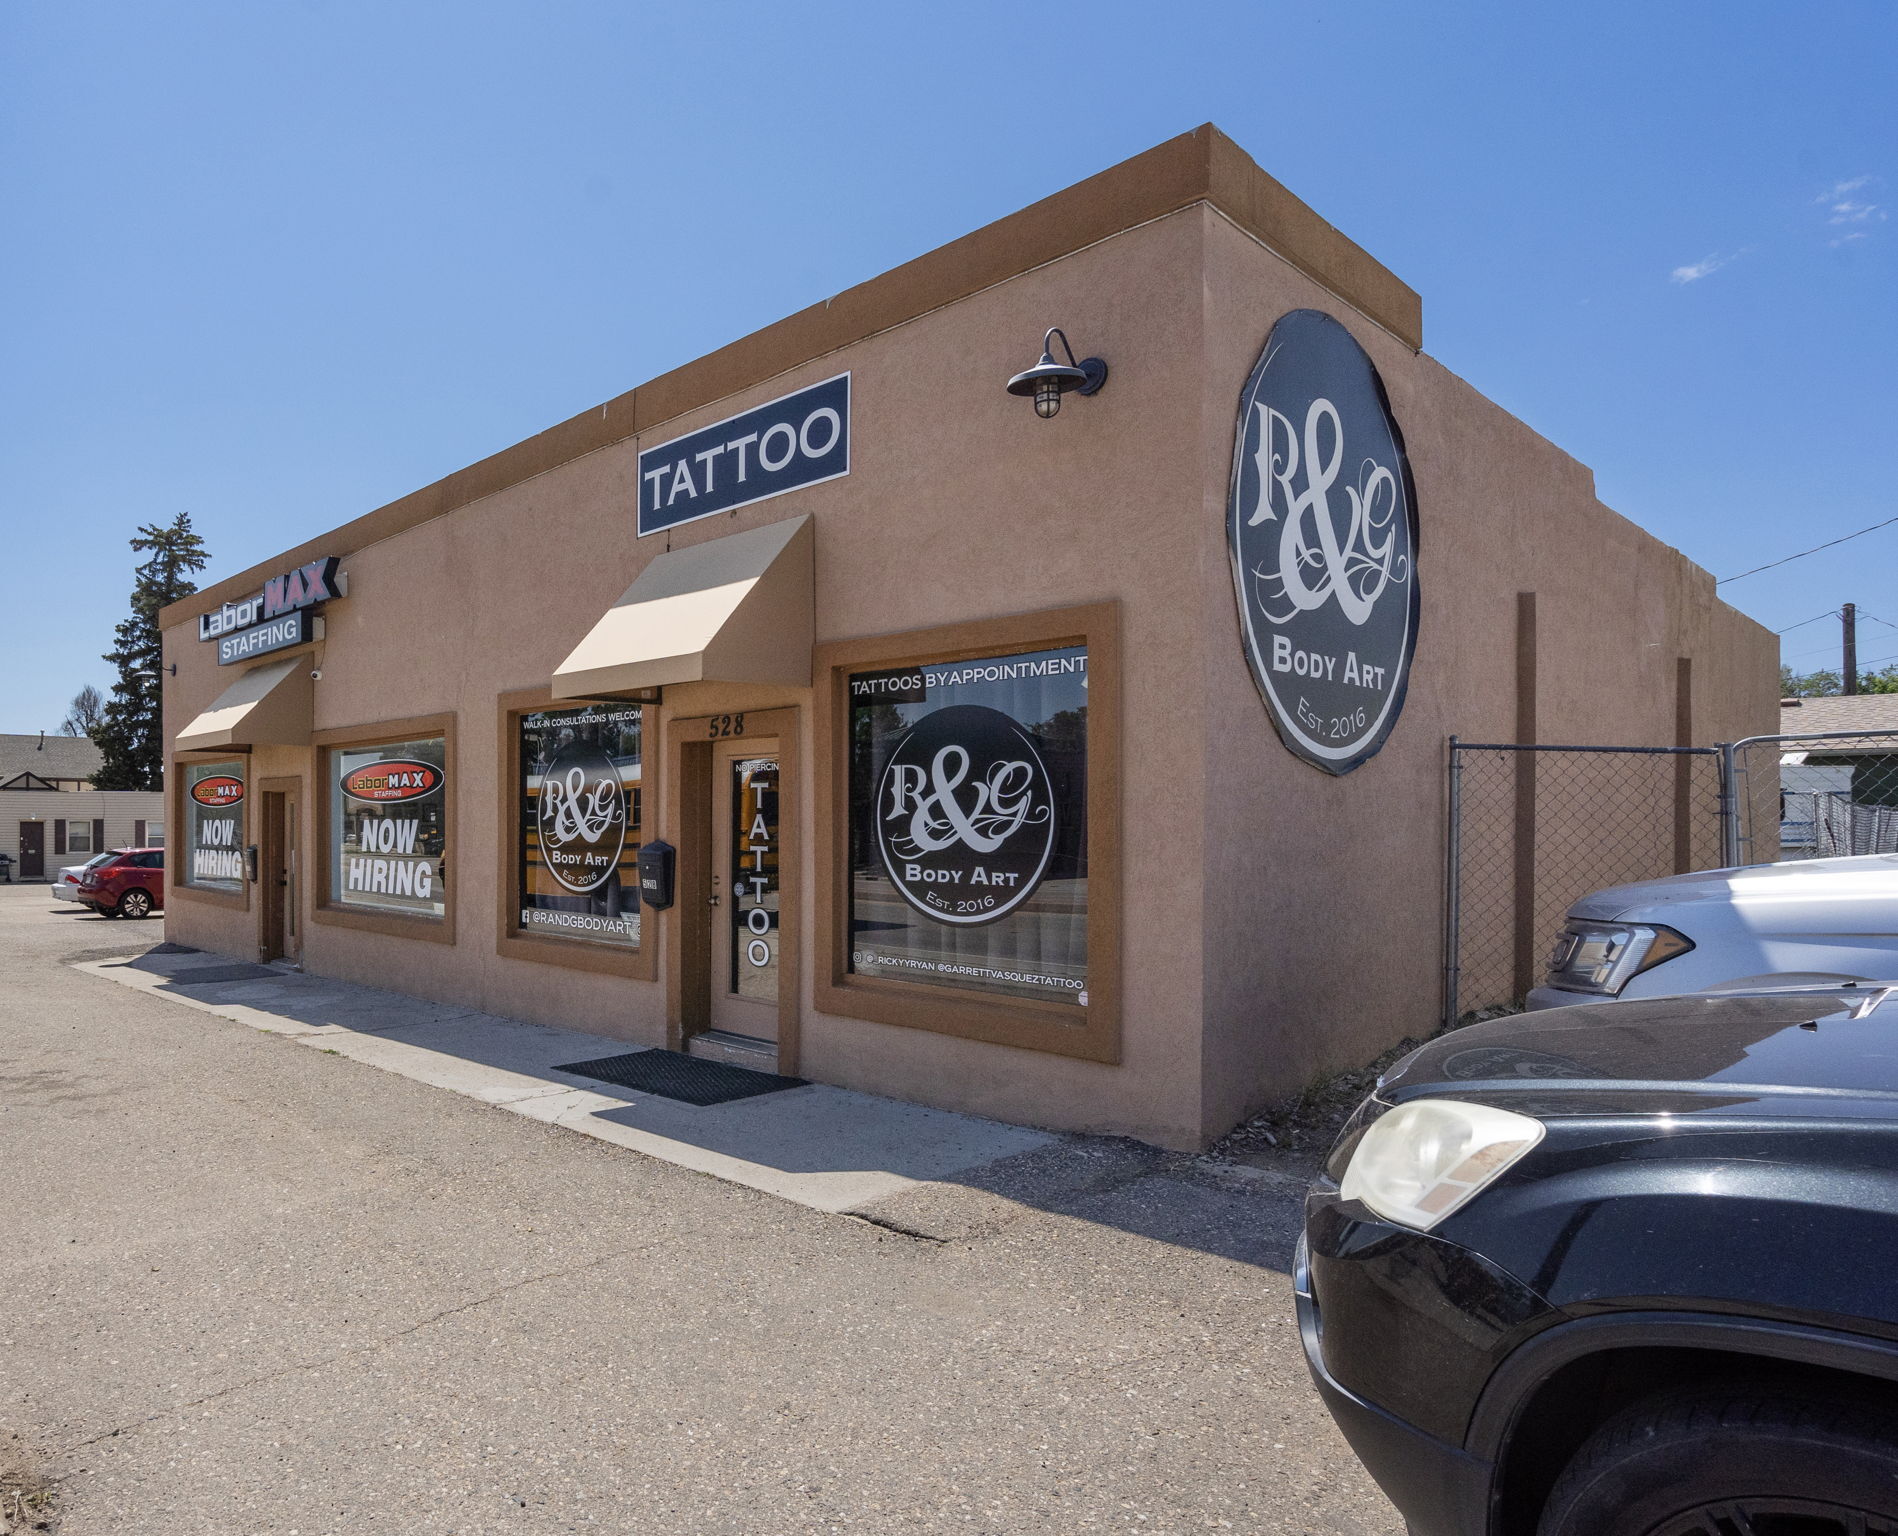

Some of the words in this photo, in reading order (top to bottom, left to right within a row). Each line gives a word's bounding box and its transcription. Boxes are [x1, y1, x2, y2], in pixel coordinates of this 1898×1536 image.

[645, 407, 840, 511] TATTOO
[1248, 397, 1408, 627] R&G
[199, 560, 335, 642] LaborMAX
[222, 620, 297, 659] STAFFING
[851, 675, 921, 695] TATTOOS
[925, 671, 948, 688] BY
[947, 656, 1088, 685] APPOINTMENT
[523, 718, 550, 730] WALK-IN
[551, 714, 606, 727] CONSULTATIONS
[709, 712, 745, 738] 528
[1330, 706, 1366, 738] 2016
[351, 772, 425, 791] LaborMAX
[735, 764, 748, 772] NO
[374, 790, 402, 798] STAFFING
[541, 767, 623, 848] R&G
[884, 745, 1050, 860] R&G
[203, 820, 234, 846] NOW
[361, 818, 418, 854] NOW
[194, 849, 242, 878] HIRING
[349, 858, 432, 898] HIRING
[577, 871, 597, 885] 2016
[747, 782, 771, 968] TATTOO
[957, 895, 995, 912] 2016
[533, 911, 631, 935] @RANDGBODYART
[937, 963, 1085, 989] @GARRETTVASQUEZTATTOO
